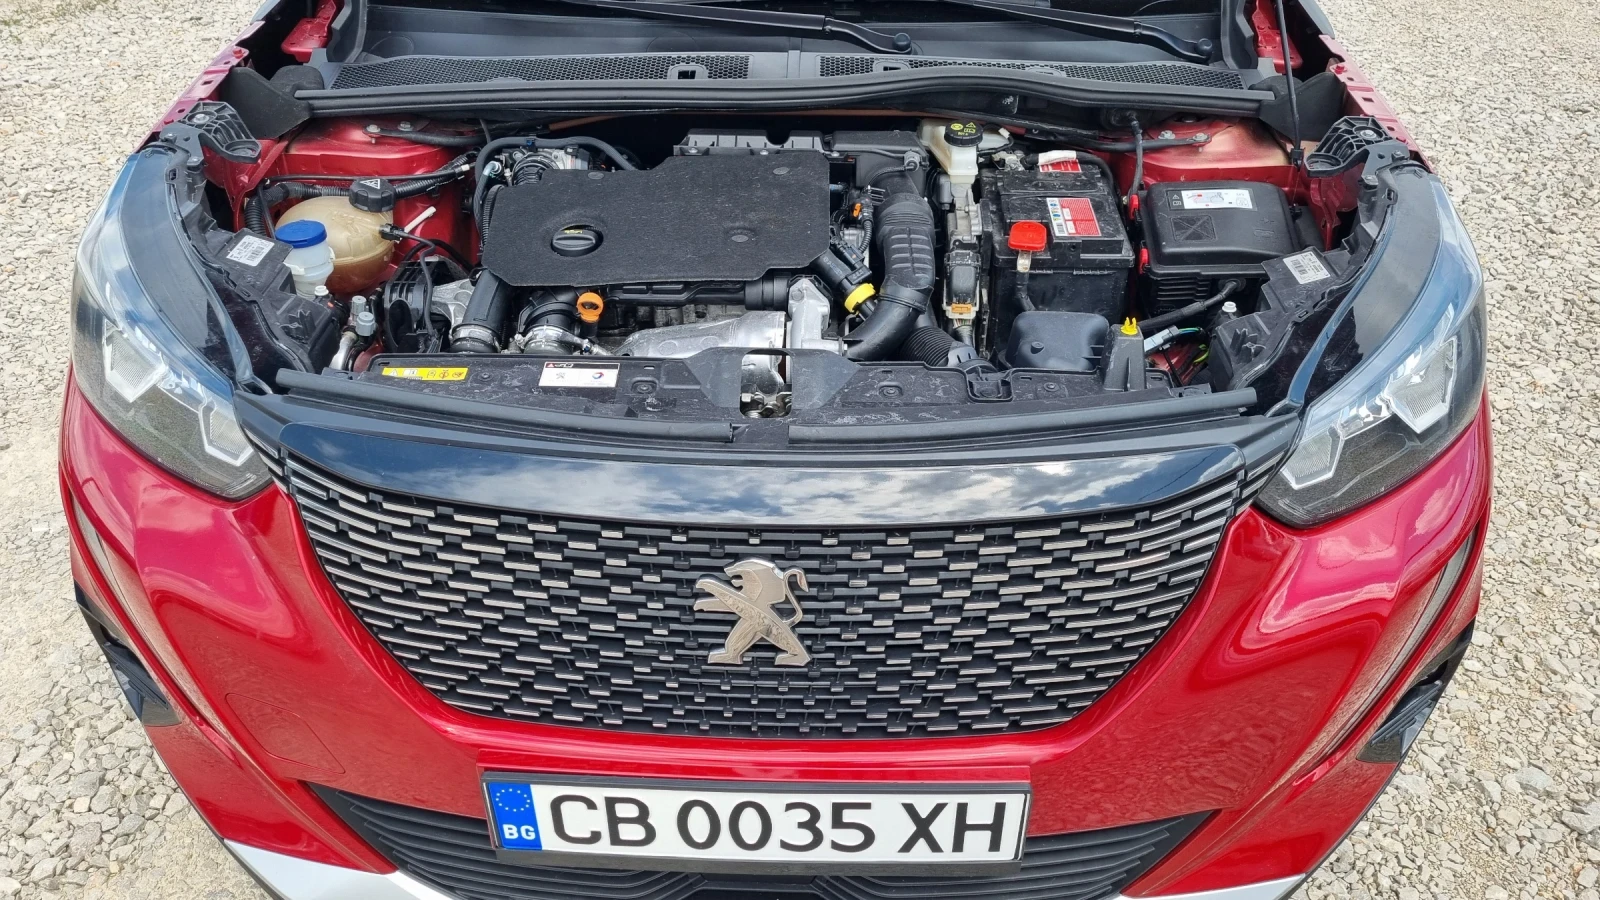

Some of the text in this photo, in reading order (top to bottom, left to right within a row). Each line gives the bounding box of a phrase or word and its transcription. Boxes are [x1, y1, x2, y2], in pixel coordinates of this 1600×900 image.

[503, 825, 536, 840] BG
[550, 795, 1006, 853] CB 0035 XH
